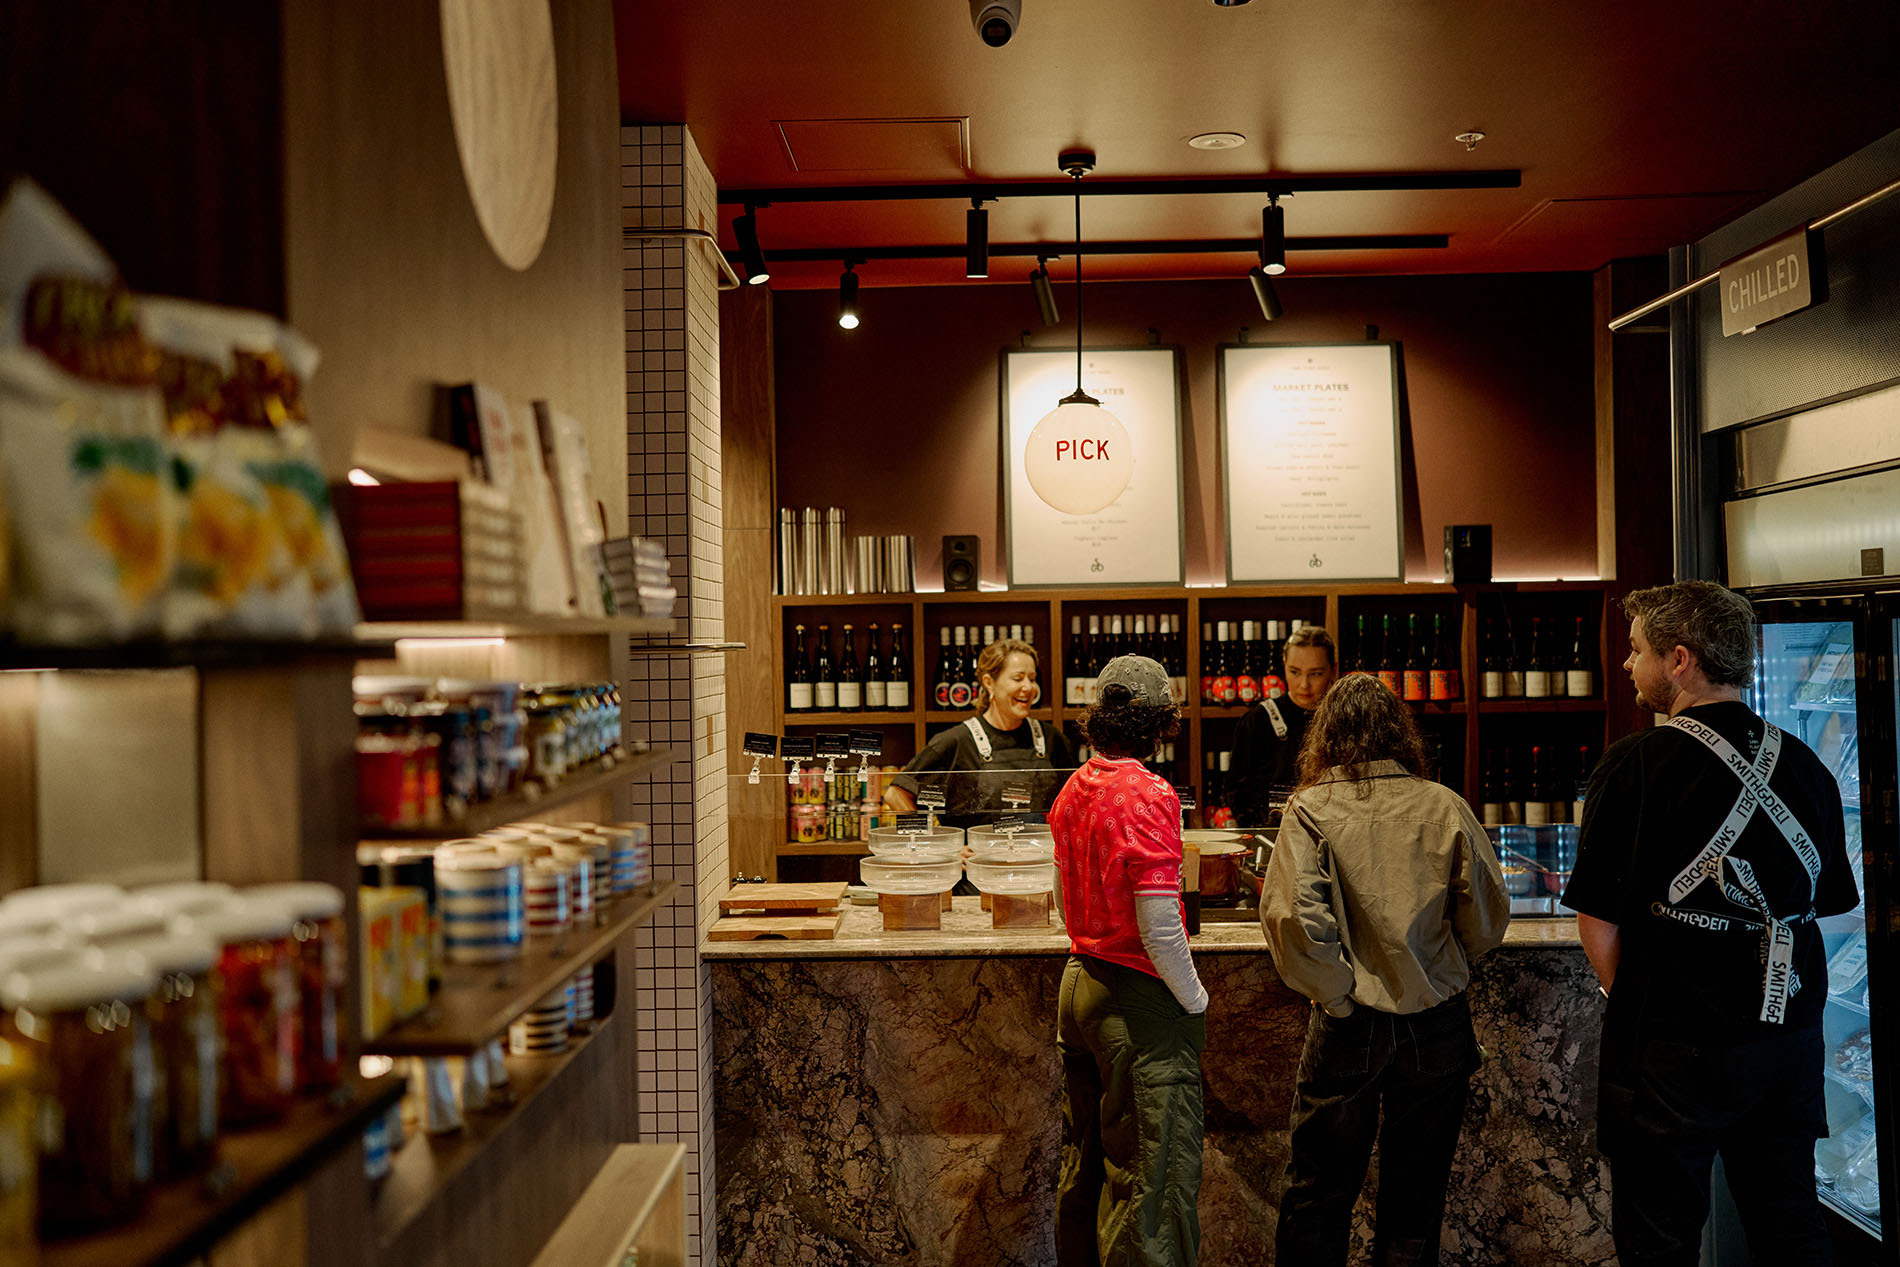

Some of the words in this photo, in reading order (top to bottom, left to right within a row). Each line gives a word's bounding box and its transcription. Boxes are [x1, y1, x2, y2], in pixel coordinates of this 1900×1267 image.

[1728, 254, 1800, 314] CHILLED
[1314, 383, 1350, 392] PLATES
[1056, 439, 1110, 461] PICK
